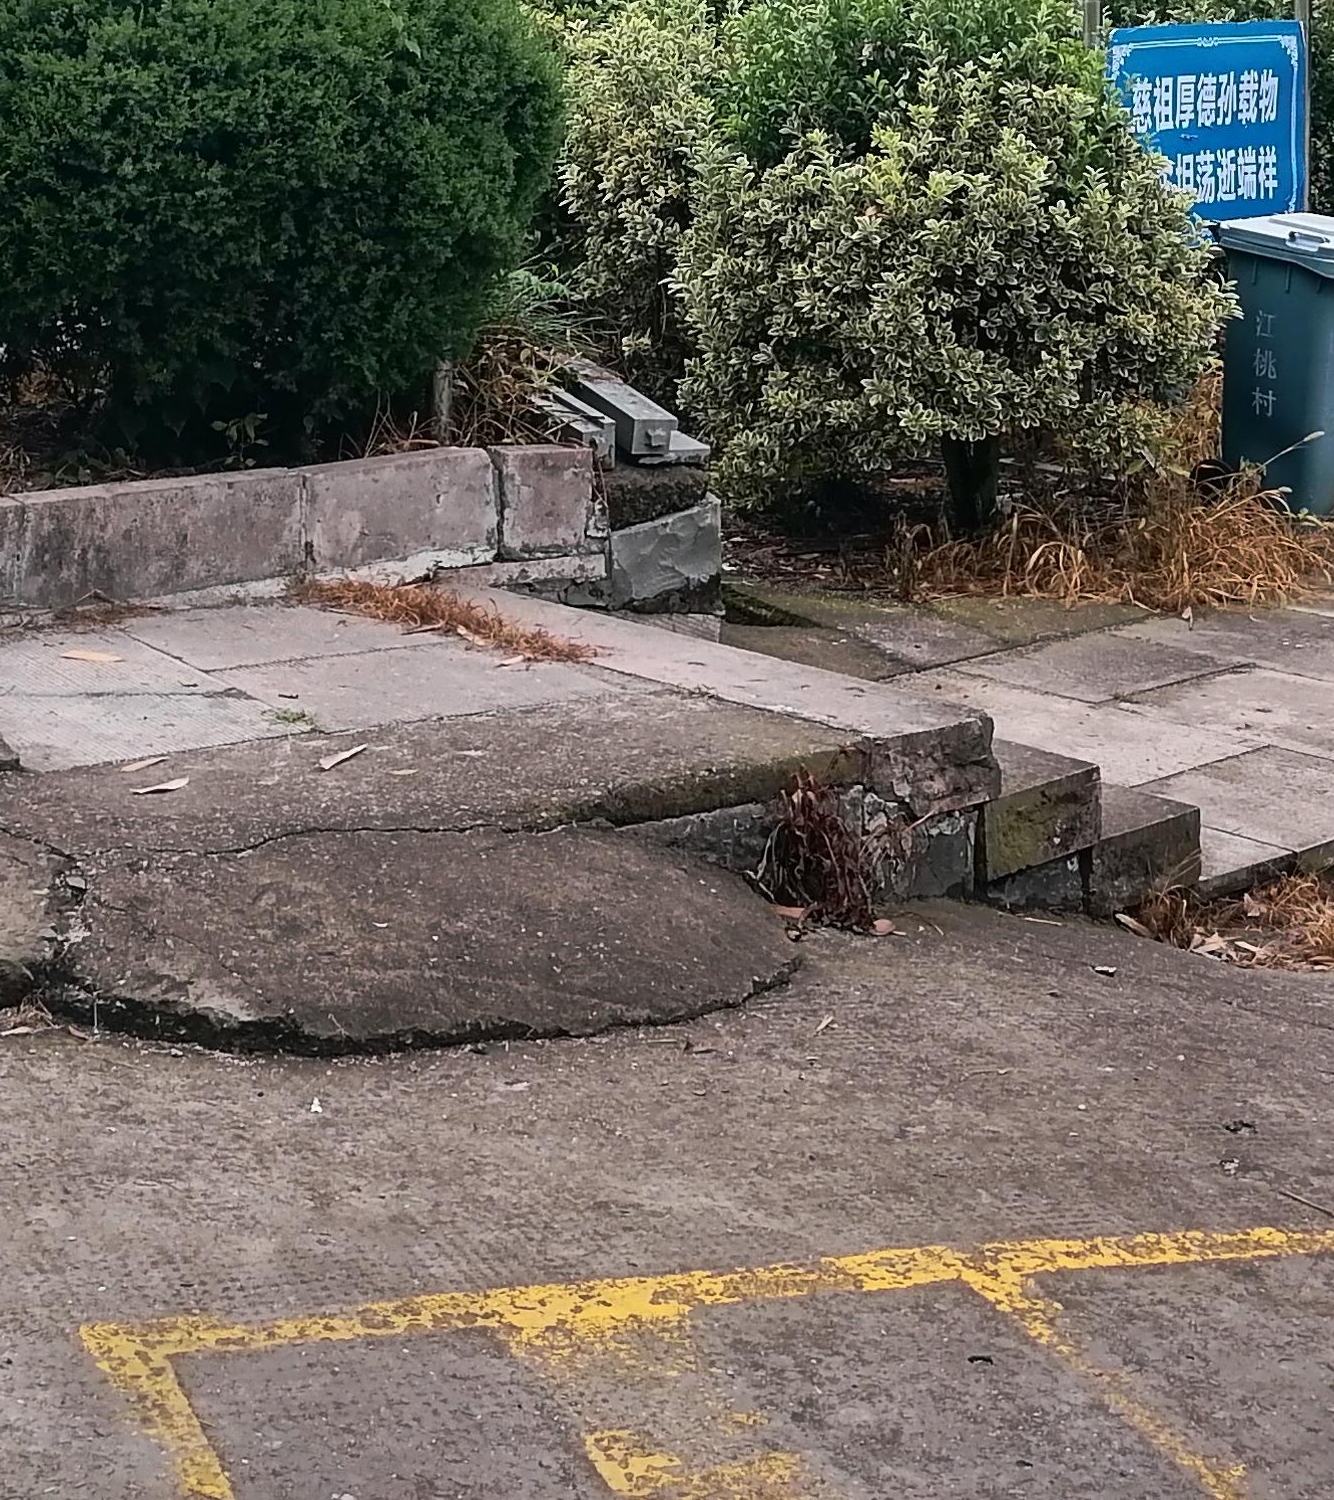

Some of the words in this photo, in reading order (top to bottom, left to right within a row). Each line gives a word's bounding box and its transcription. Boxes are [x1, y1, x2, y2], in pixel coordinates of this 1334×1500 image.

[1157, 145, 1279, 204] 坦荡逝端祥
[1251, 309, 1278, 418] 江桃村
